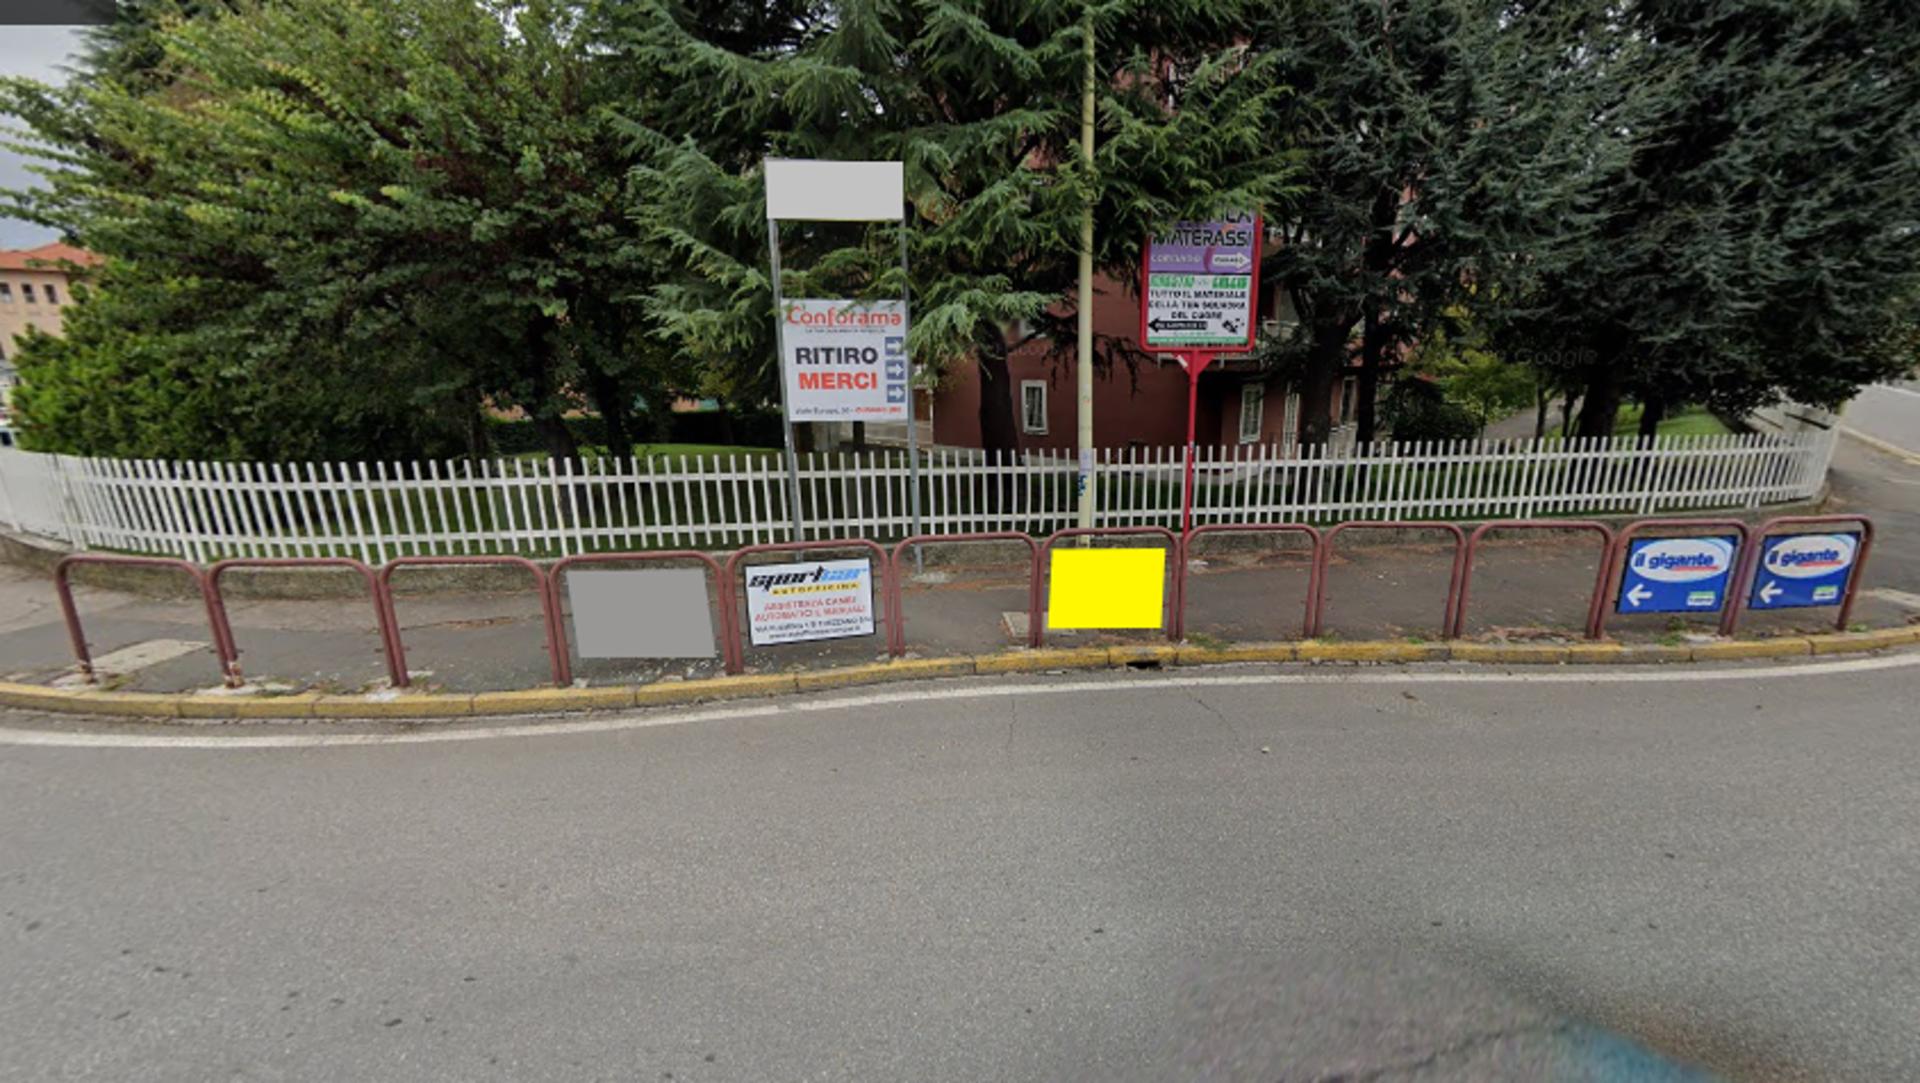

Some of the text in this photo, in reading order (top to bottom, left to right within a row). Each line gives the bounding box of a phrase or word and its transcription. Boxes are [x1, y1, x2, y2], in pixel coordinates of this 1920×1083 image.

[1152, 229, 1252, 247] MATERASSI
[787, 304, 902, 327] Conforama
[796, 347, 878, 365] RITIRO
[798, 372, 878, 390] MERCI
[1634, 552, 1715, 570] il gigante
[1781, 549, 1840, 567] gigante
